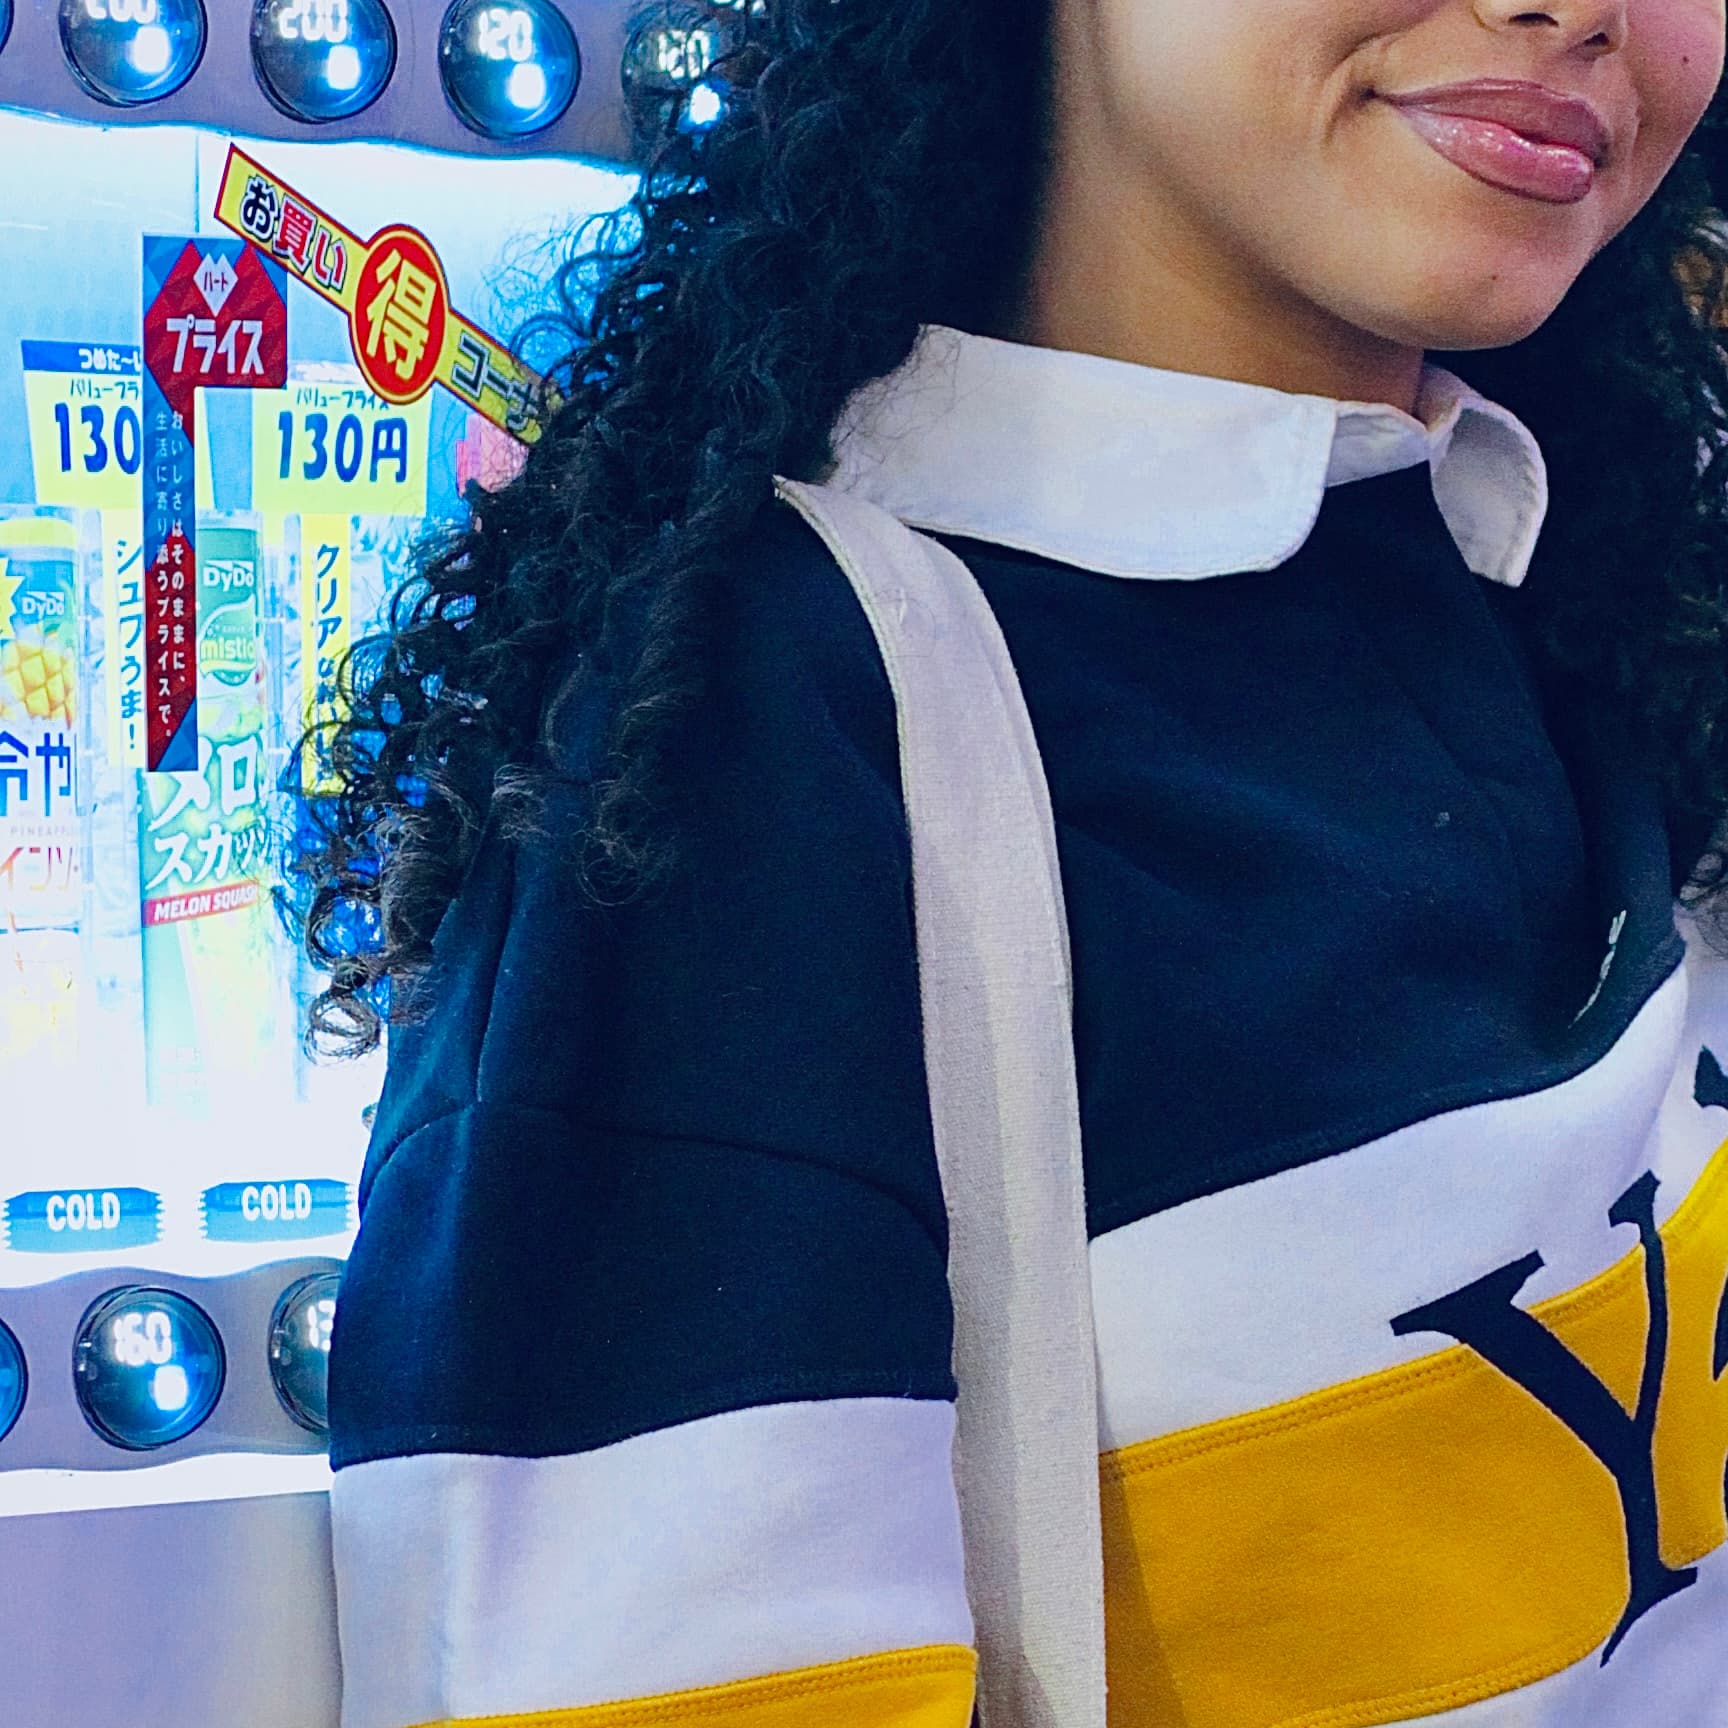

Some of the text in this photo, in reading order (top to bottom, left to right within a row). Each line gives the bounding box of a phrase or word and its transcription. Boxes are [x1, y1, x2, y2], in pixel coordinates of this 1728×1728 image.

[478, 8, 533, 62] 120
[203, 272, 229, 292] ハート
[166, 314, 265, 375] プライス
[54, 402, 141, 475] 130
[278, 410, 408, 483] 130円
[203, 560, 254, 592] DyDo
[22, 592, 65, 620] DyDo
[154, 892, 210, 922] MELON
[47, 1193, 120, 1232] COLD
[241, 1183, 313, 1222] COLD
[111, 1312, 172, 1366] 160
